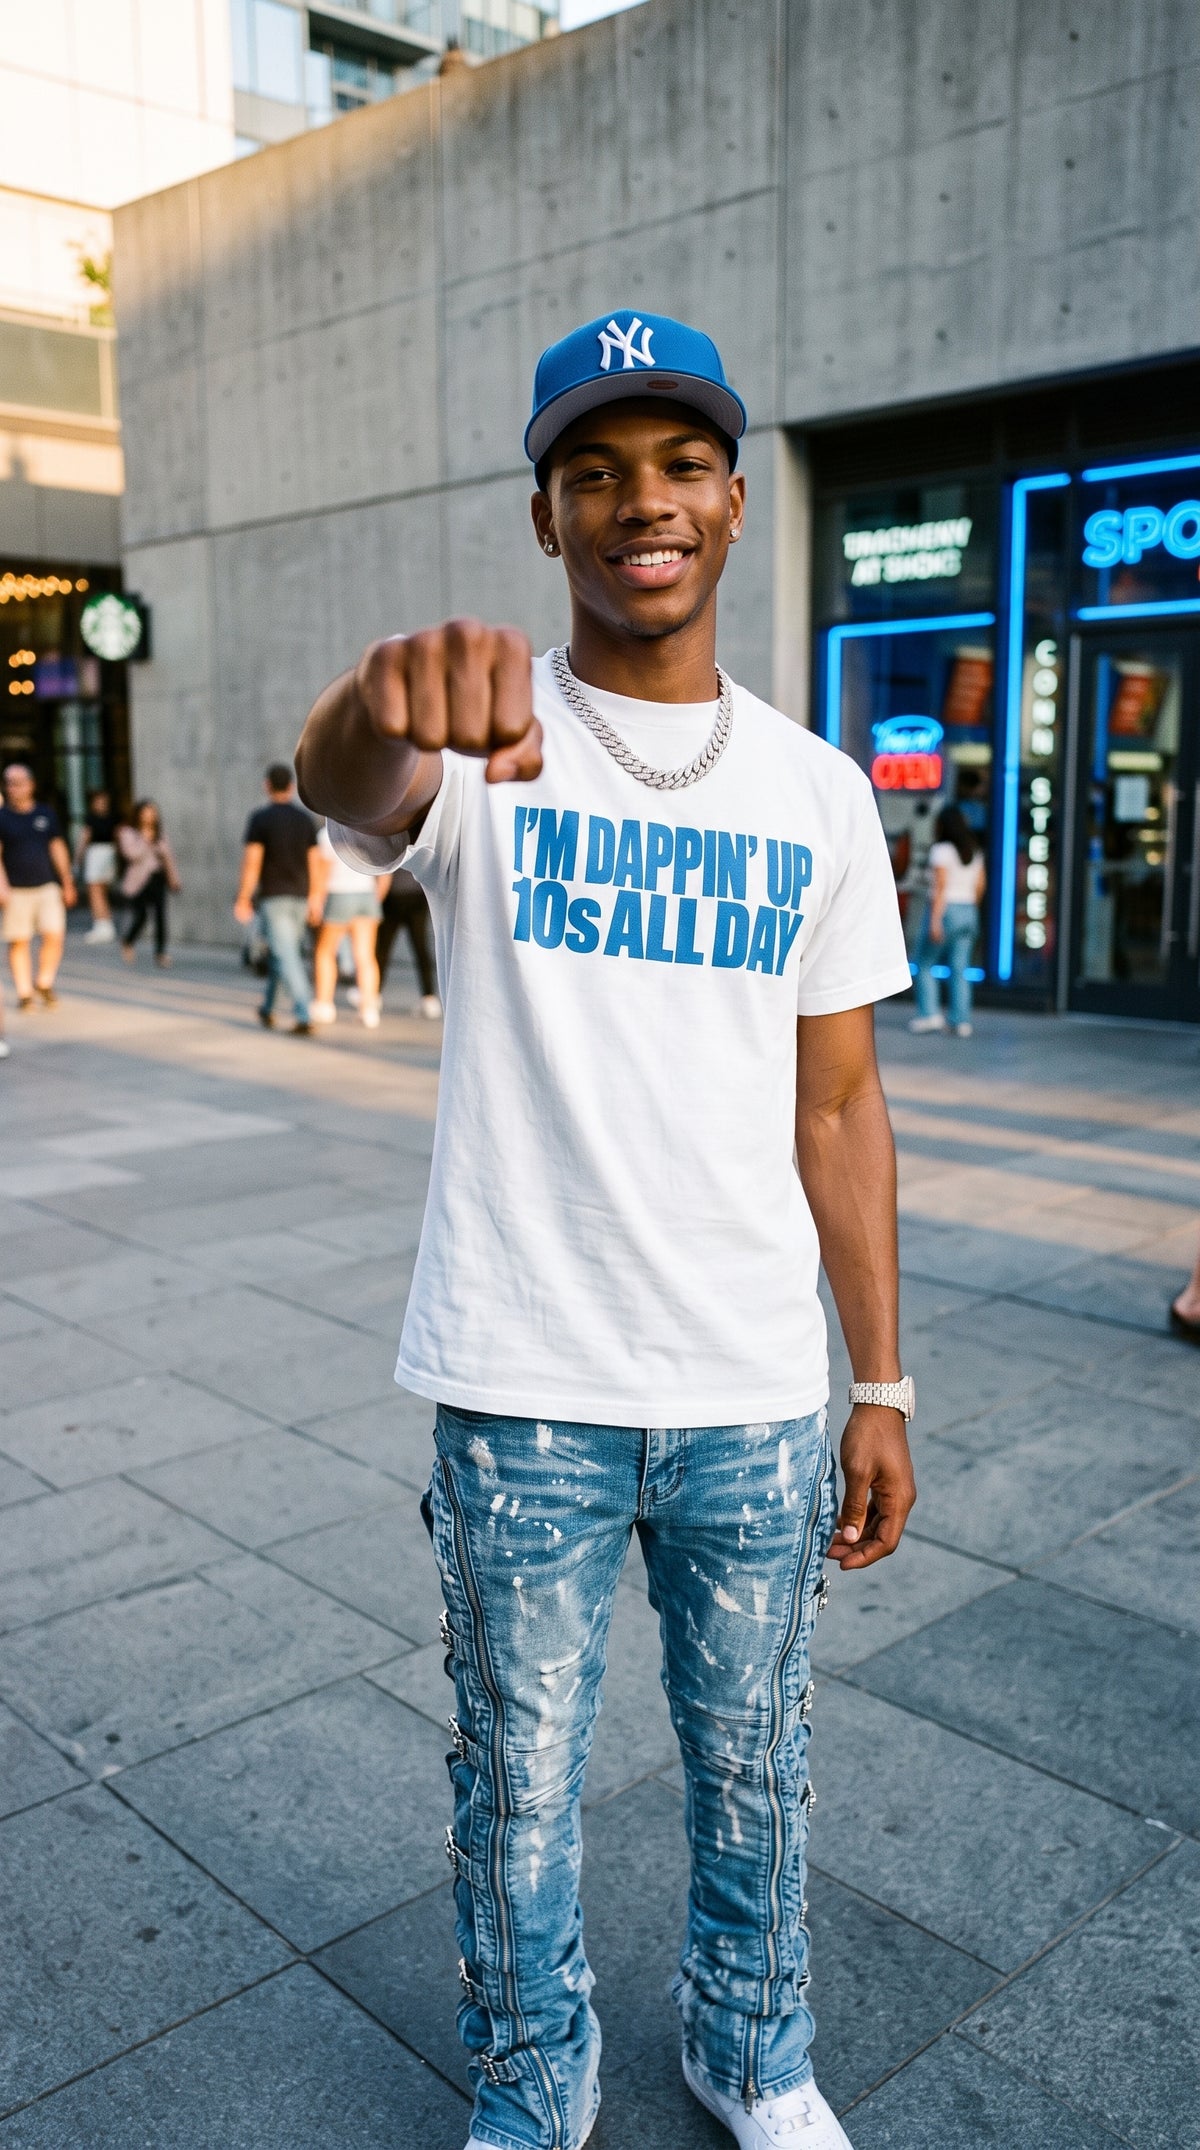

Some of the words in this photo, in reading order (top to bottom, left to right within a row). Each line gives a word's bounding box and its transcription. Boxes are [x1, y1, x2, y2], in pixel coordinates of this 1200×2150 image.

[597, 317, 656, 371] NY
[514, 806, 580, 881] I'M
[584, 814, 758, 900] DAPPIN'
[766, 838, 813, 910] UP
[603, 889, 704, 965] ALL
[711, 901, 804, 976] DAY
